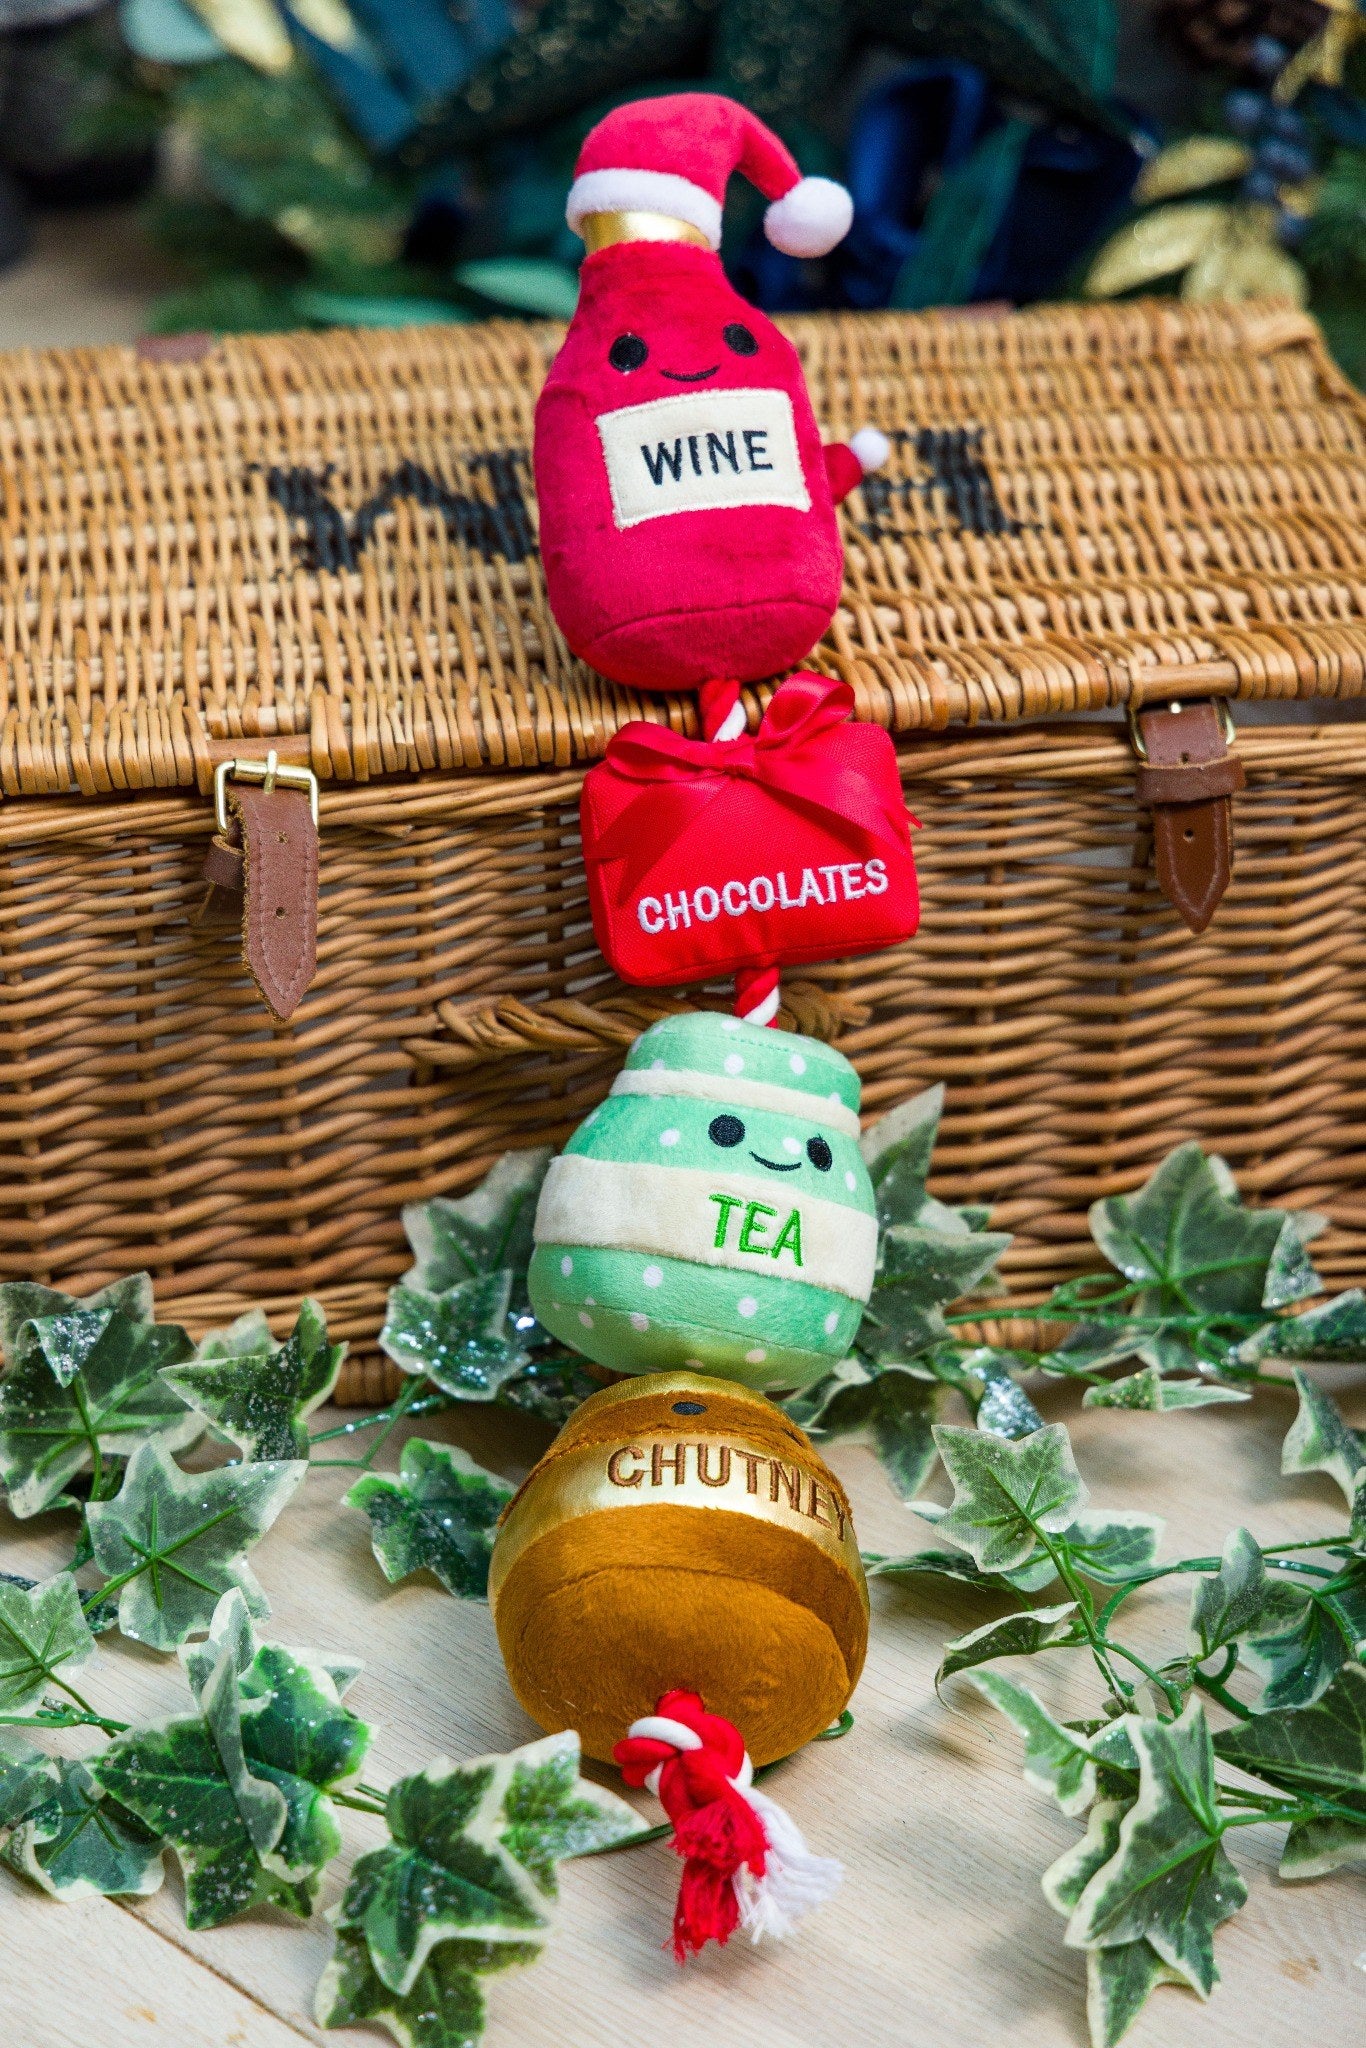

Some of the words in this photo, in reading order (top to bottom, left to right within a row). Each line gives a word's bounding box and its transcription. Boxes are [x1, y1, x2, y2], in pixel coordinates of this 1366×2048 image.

[640, 430, 772, 486] WINE
[637, 858, 889, 934] CHOCOLATES
[709, 1193, 803, 1267] TEA
[607, 1443, 845, 1541] CHUTNEY
